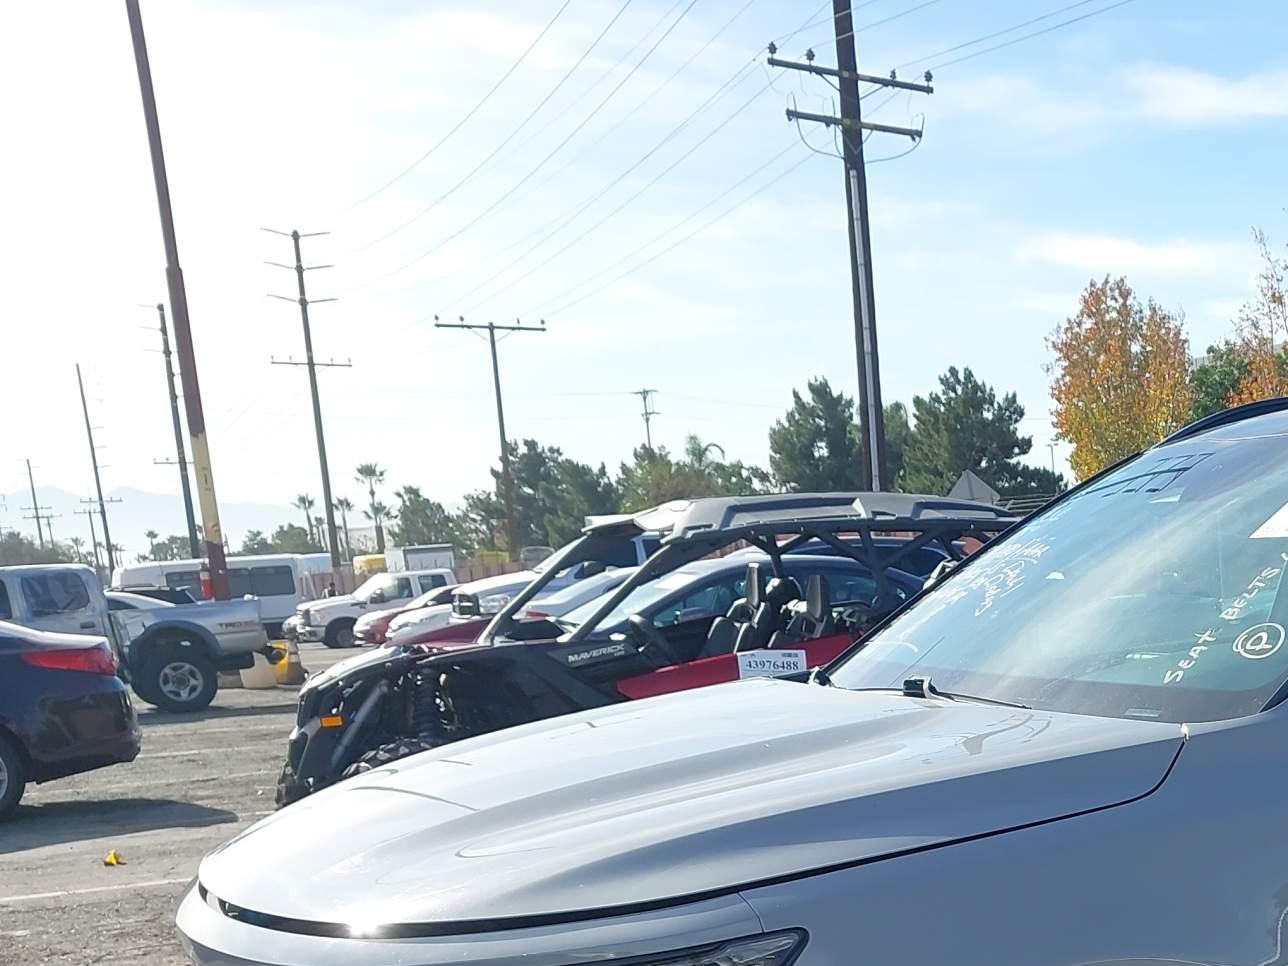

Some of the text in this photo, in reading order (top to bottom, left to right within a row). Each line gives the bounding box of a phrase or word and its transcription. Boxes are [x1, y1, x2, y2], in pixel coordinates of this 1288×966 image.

[1219, 567, 1281, 620] BELTS
[567, 643, 626, 663] MAVERICK
[745, 659, 799, 672] 43976488
